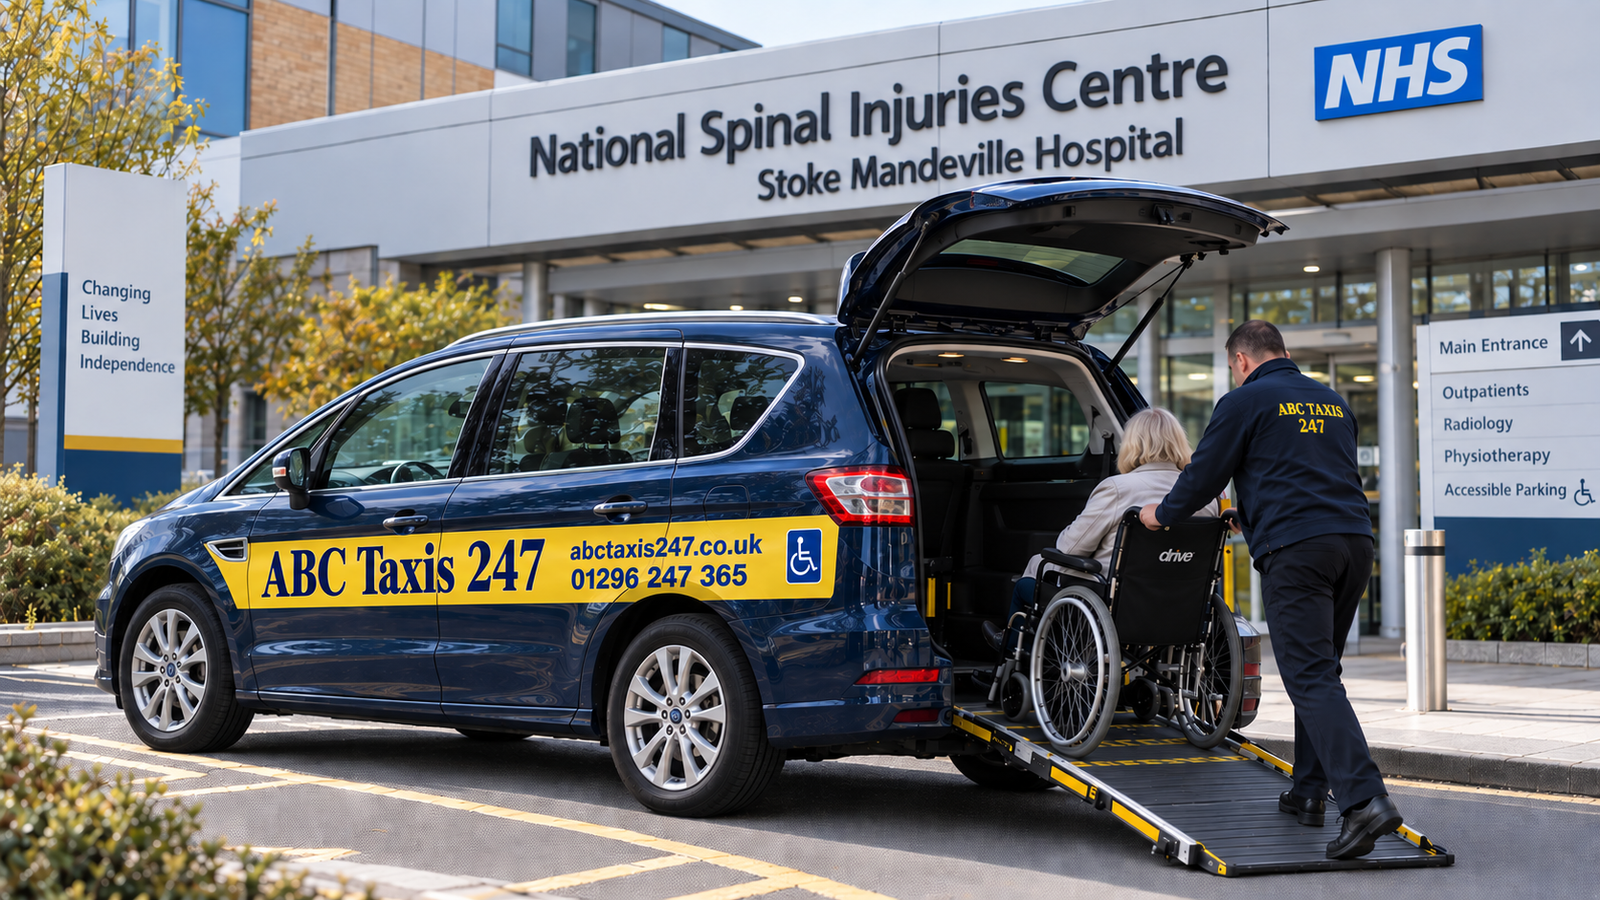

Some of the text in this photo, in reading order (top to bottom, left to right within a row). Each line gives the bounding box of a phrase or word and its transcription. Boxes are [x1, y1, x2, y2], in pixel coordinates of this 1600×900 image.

[1324, 36, 1471, 110] NHS
[530, 52, 1230, 178] National Spinal Injuries Centre
[757, 117, 1184, 201] Stoke Mandeville Hospital
[82, 280, 151, 304] Changing
[82, 304, 119, 322] Lives
[81, 329, 140, 351] Building
[1439, 338, 1549, 354] Main Entrance
[80, 353, 175, 374] Independence
[1442, 383, 1530, 402] Outpatients
[1278, 402, 1344, 418] ABC TAXIS
[1298, 418, 1325, 434] 247
[1444, 416, 1514, 433] Radiology
[1444, 448, 1551, 466] Physiotherapy
[1444, 482, 1567, 500] Accessible Parking
[570, 533, 763, 561] abctaxis247.co.uk
[1158, 548, 1194, 562] drive
[261, 538, 546, 598] ABC Taxis 247
[571, 563, 748, 590] 01296 247 365
